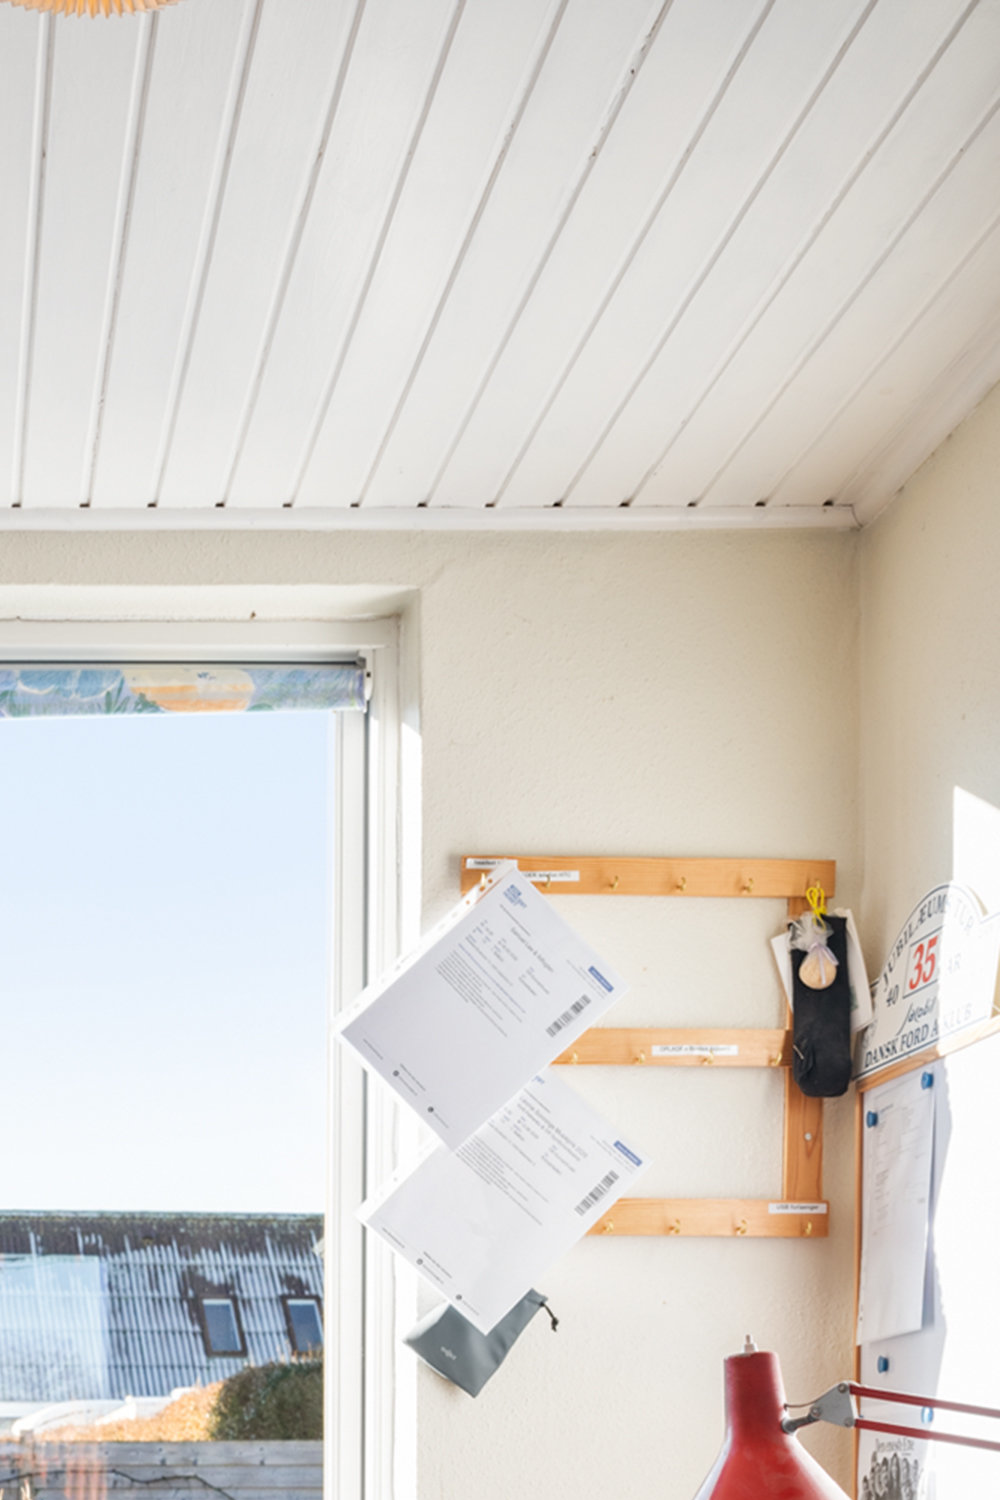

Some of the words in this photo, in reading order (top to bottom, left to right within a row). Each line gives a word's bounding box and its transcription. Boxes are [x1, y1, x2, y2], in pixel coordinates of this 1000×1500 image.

[909, 935, 939, 991] 35
[864, 1034, 900, 1069] DANSK
[900, 1021, 933, 1054] FORD
